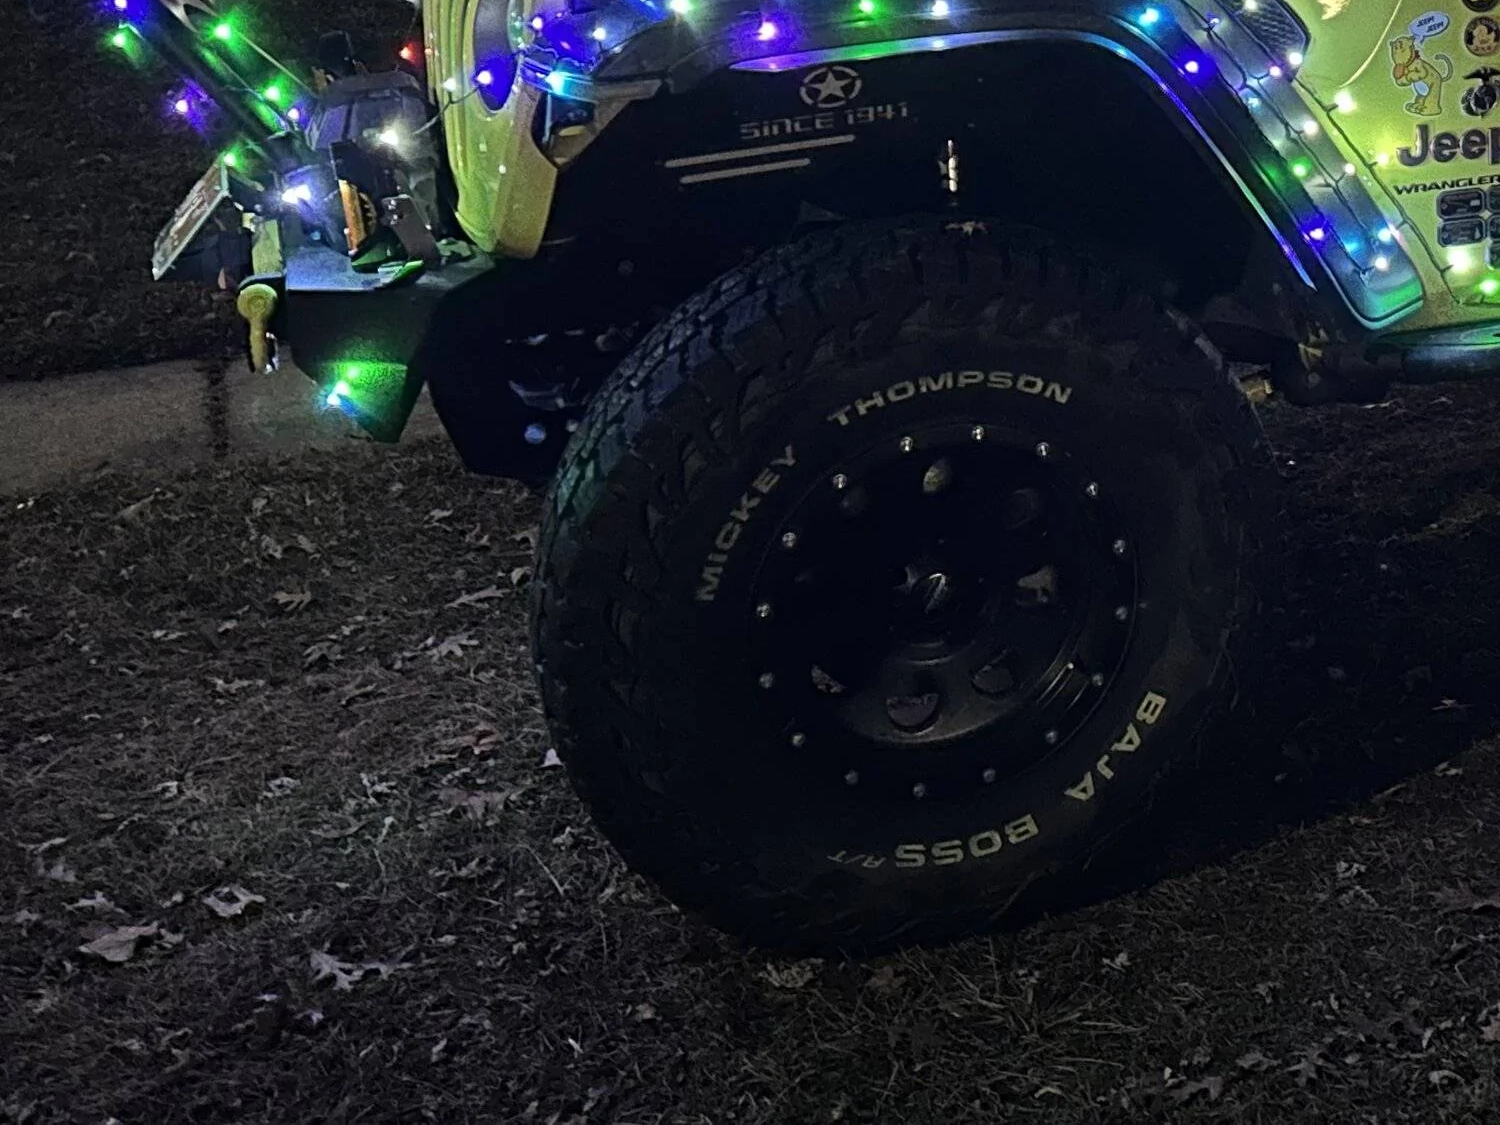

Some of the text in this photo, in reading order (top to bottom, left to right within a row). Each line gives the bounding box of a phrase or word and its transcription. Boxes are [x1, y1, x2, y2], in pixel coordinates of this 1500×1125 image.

[696, 370, 1073, 602] MICKEY THOMPSON
[1064, 691, 1167, 802] BAJA
[895, 813, 1040, 869] BOSS
